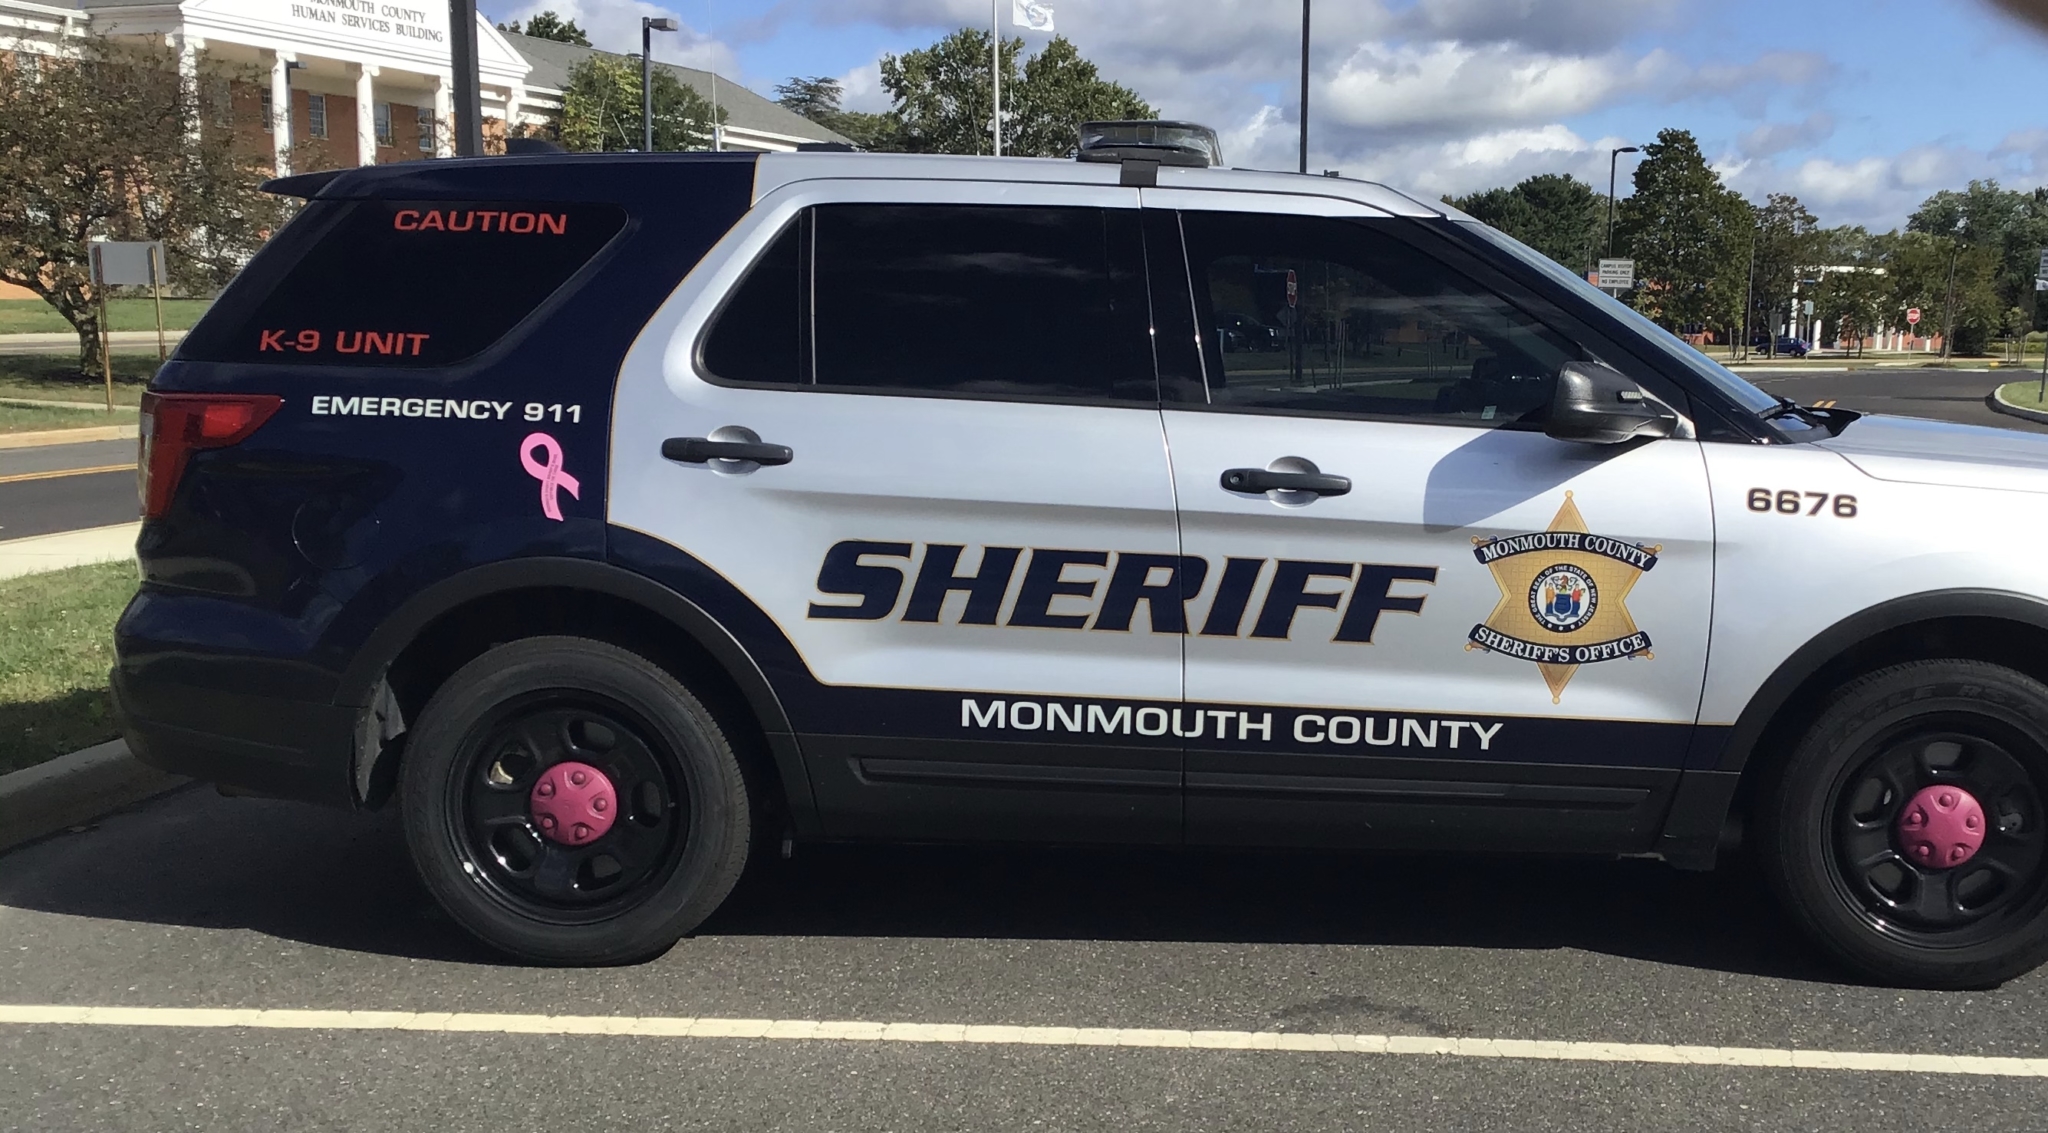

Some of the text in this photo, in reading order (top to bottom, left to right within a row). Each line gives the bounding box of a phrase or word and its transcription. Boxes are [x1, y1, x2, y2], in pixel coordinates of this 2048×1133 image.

[291, 4, 443, 42] HUMAN SERVICES BUILDING
[310, 0, 426, 23] NMOUTH COUNTY
[394, 210, 567, 235] CAUTION
[259, 329, 429, 356] K-9 UNIT
[311, 396, 581, 424] EMERGENCY 911
[1747, 487, 1858, 519] 6676
[1480, 533, 1652, 568] MONMOUTH COUNTY
[1544, 568, 1553, 576] OF
[1569, 566, 1586, 580] STATE
[805, 538, 1440, 645] SHERIFF
[1474, 627, 1645, 663] SHERIFF'S OFFICE
[961, 699, 1504, 750] MONMOUTH COUNTY
